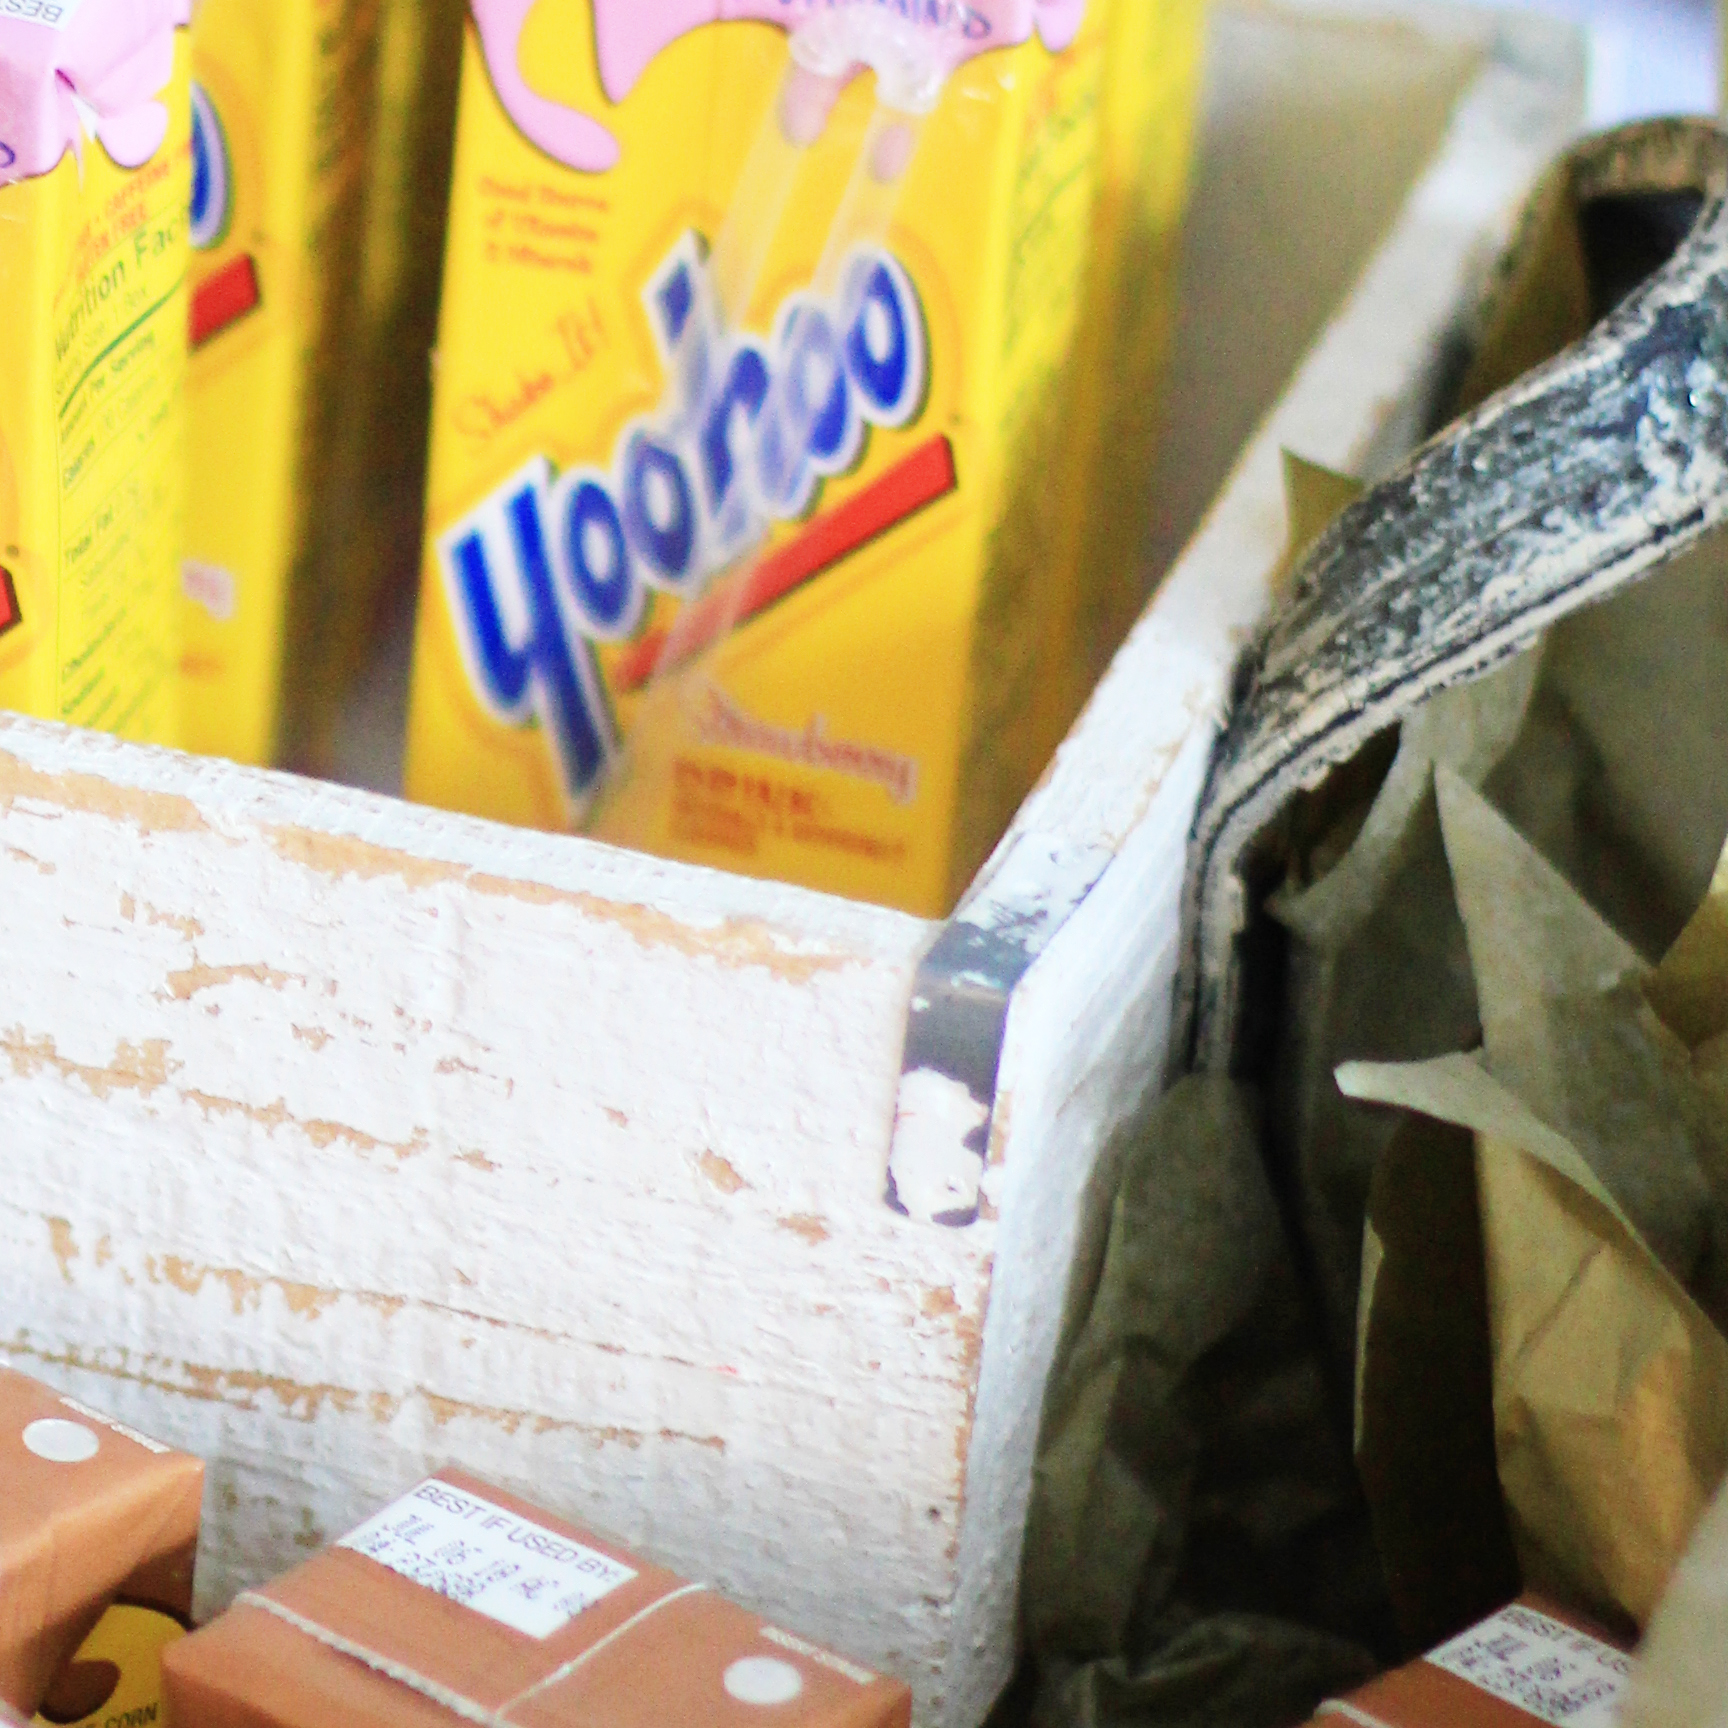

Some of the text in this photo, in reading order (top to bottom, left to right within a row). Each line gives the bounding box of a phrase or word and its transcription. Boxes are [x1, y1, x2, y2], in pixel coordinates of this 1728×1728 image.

[412, 1485, 486, 1519] BEST
[480, 1514, 512, 1531] IF
[507, 1525, 579, 1564] USED
